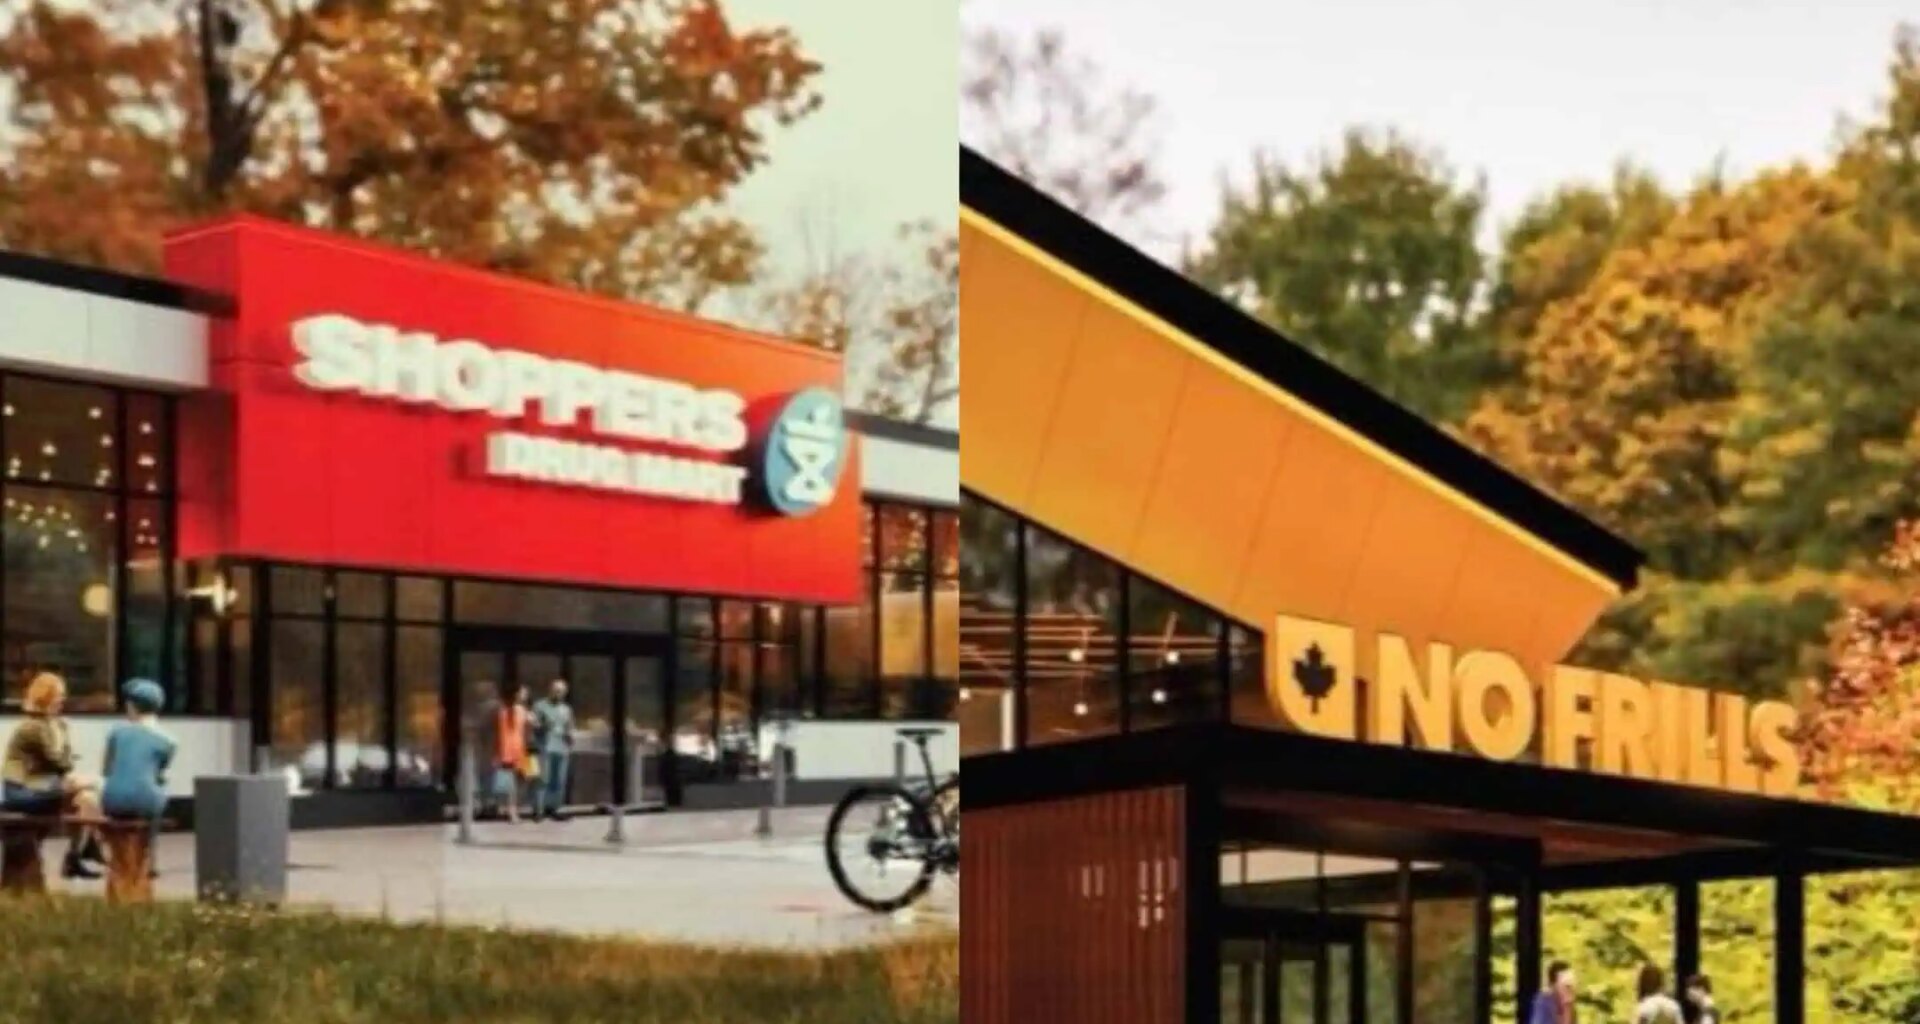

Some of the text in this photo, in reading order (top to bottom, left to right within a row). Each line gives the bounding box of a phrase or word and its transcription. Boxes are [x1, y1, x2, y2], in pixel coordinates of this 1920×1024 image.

[291, 313, 747, 450] SHOPPERS
[486, 432, 748, 504] DRUG MART
[1374, 633, 1801, 795] NO FRILLS
